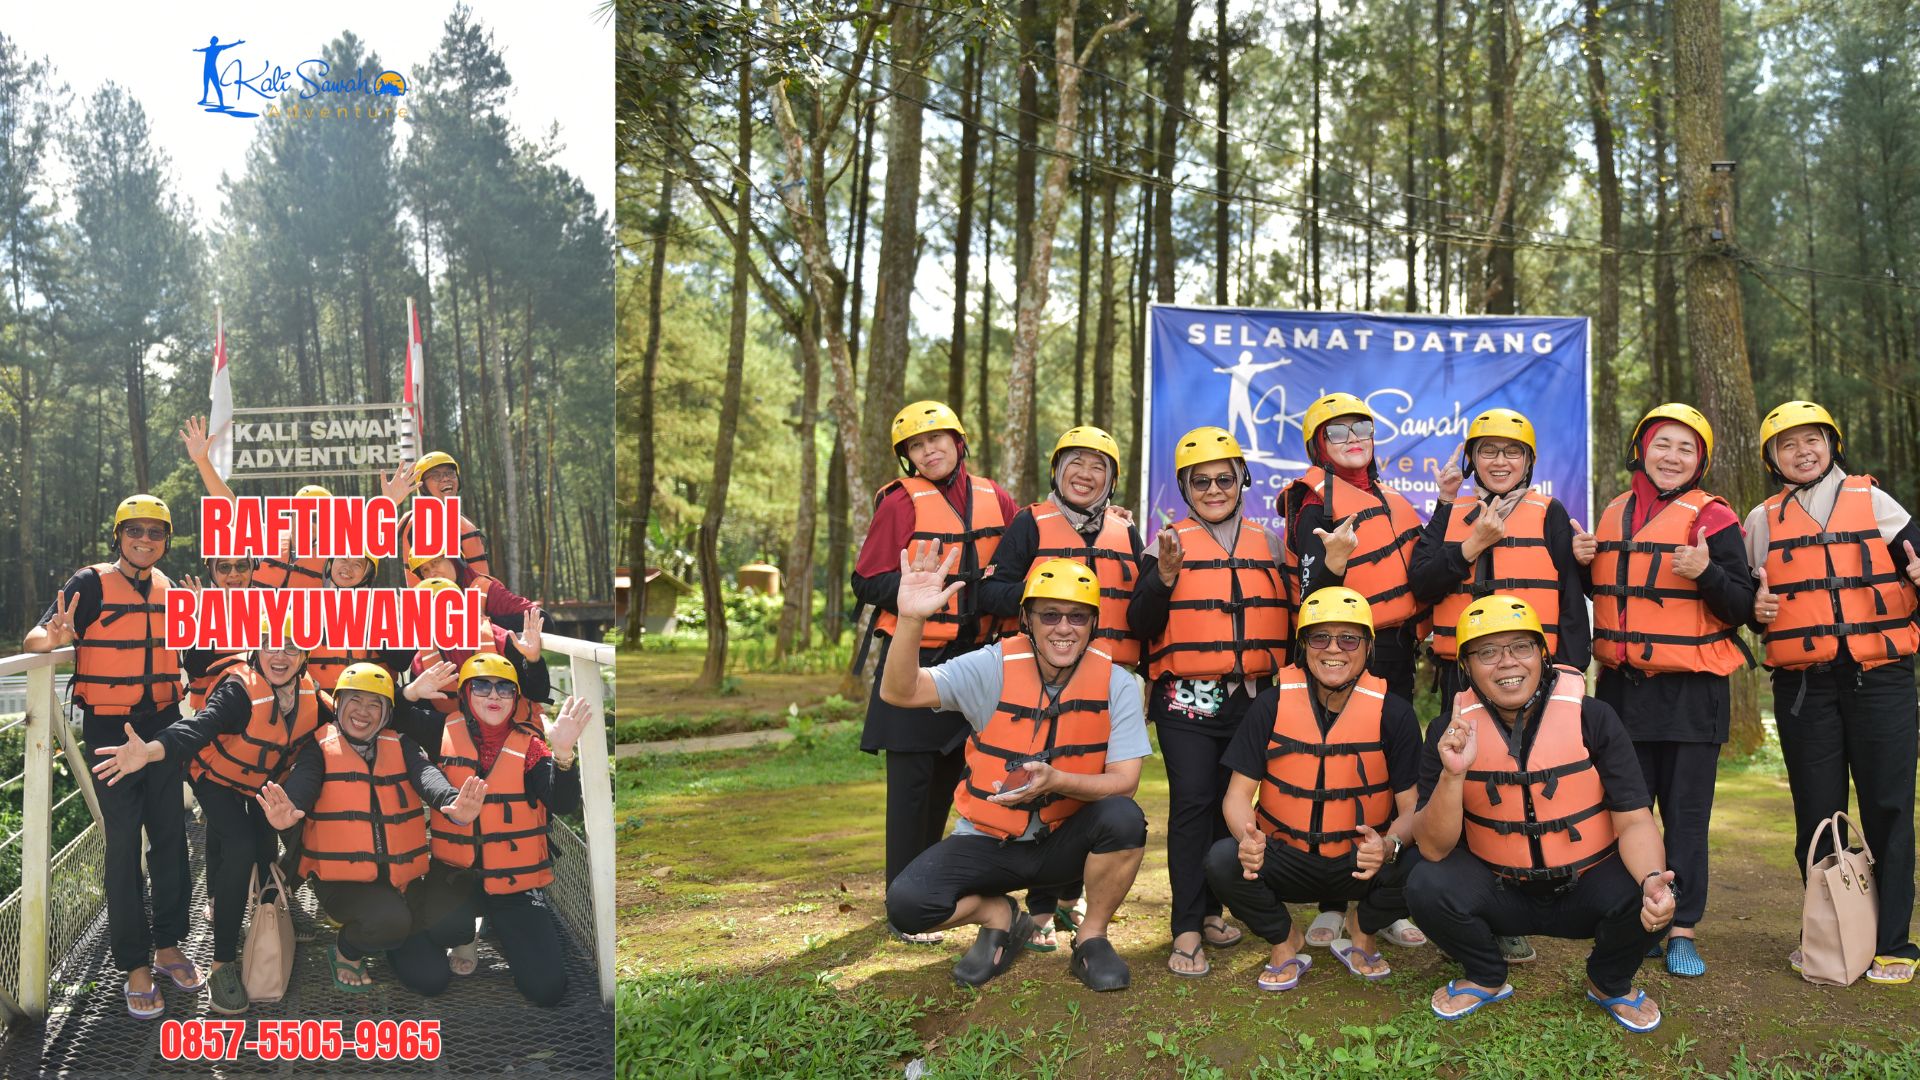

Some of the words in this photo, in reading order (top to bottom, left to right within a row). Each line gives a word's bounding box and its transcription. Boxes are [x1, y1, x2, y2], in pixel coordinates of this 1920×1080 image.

[1187, 323, 1374, 351] SELAMAT
[1393, 329, 1554, 354] DATANG
[235, 421, 299, 442] KALI
[310, 418, 401, 440] SAWAH
[1364, 388, 1469, 445] Sawah
[236, 444, 401, 469] ADVENTURE
